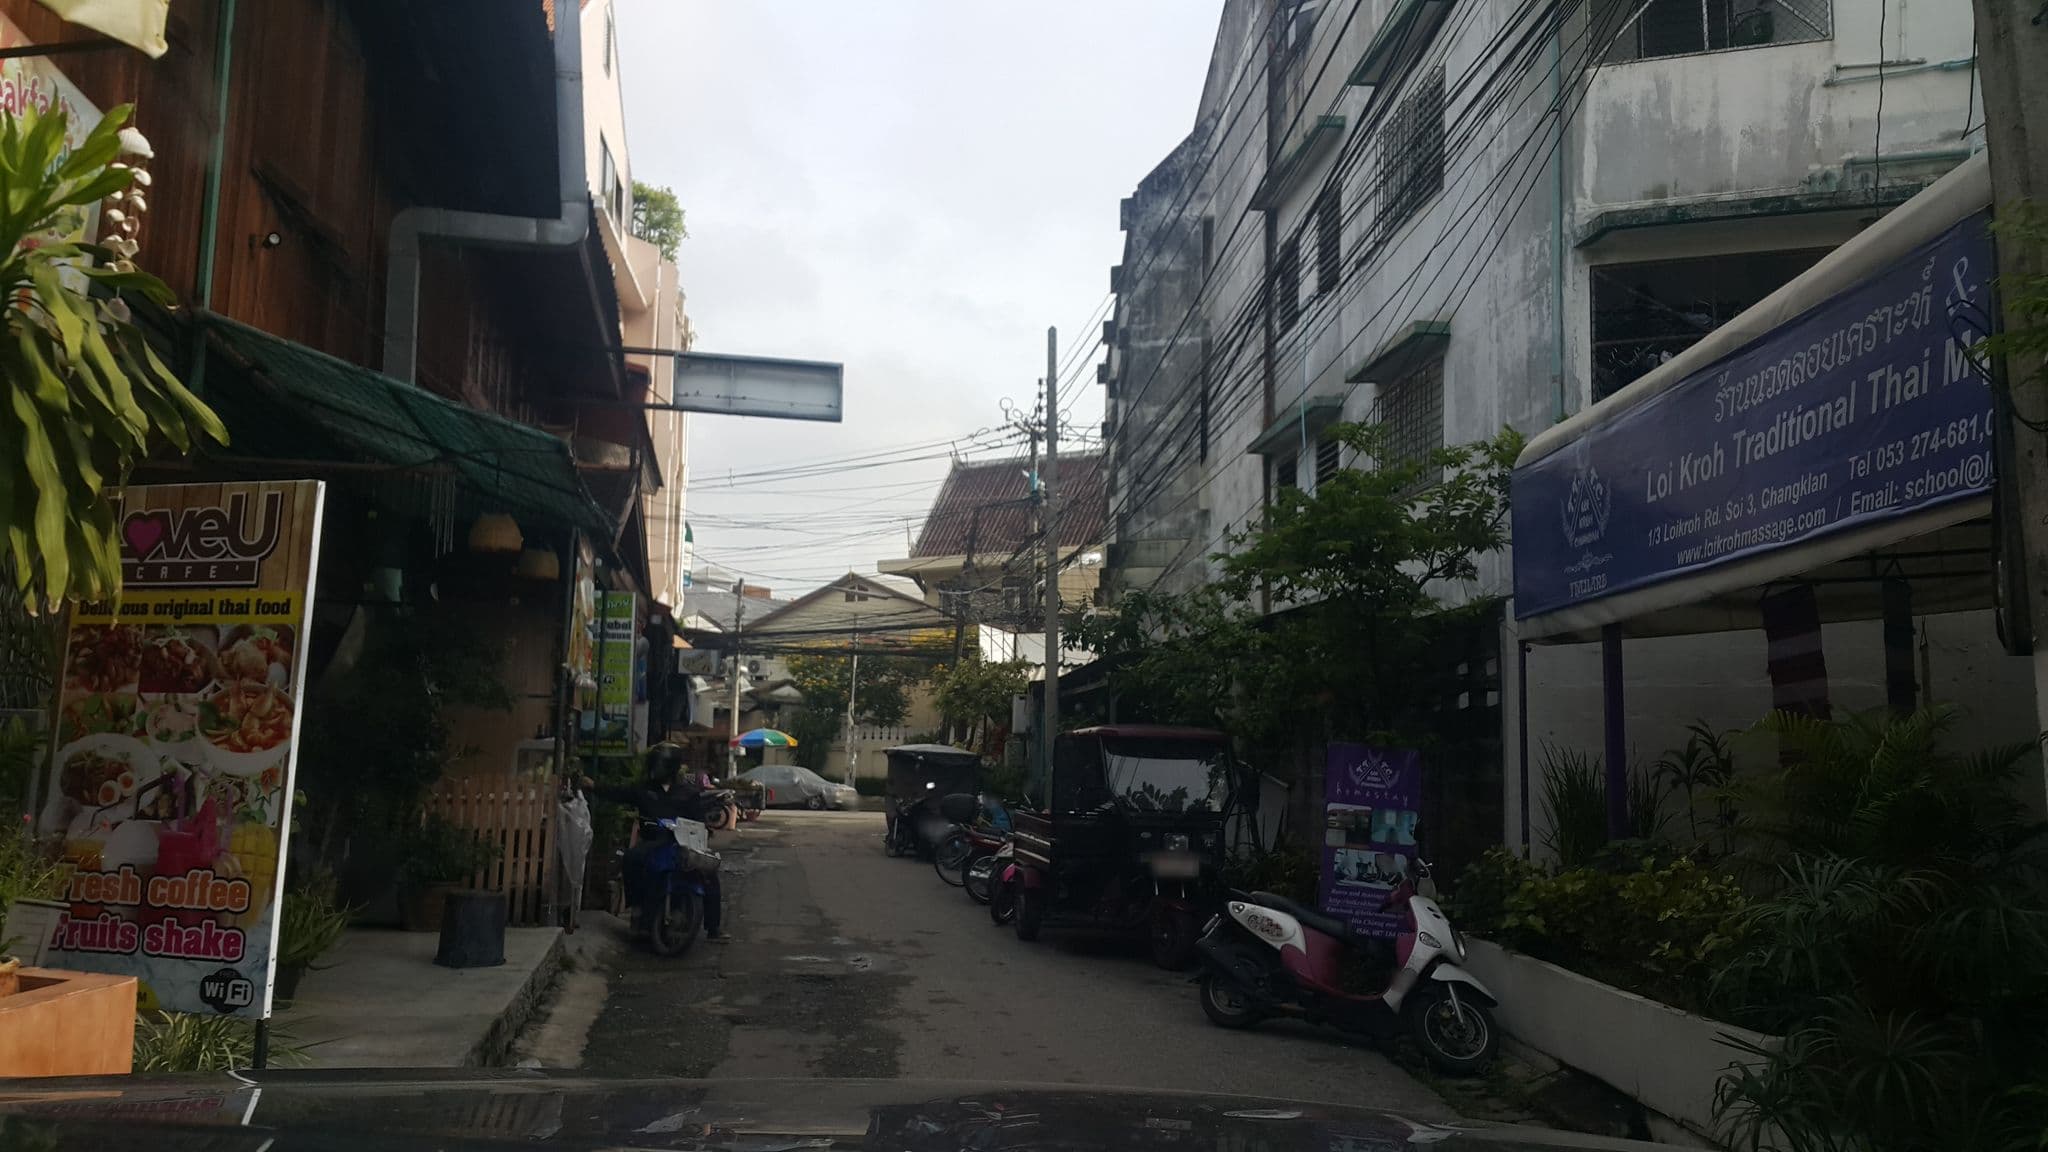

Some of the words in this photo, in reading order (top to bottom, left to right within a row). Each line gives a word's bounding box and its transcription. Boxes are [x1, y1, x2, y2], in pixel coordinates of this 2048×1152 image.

[1646, 459, 1672, 504] Loi
[1679, 441, 1725, 490] Kroh
[1733, 380, 1858, 468] Traditional
[1866, 348, 1931, 414] Thai
[1663, 513, 1701, 542] Loikroh
[1704, 506, 1722, 529] Rd.
[1725, 498, 1744, 521] Soi
[1761, 471, 1828, 508] Changklan
[1848, 450, 1870, 480] Tel
[1876, 440, 1905, 472] 053
[1677, 507, 1826, 565] www.loikrohmassage.com
[1851, 482, 1899, 519] Email:
[153, 599, 214, 619] original
[219, 599, 250, 615] thai
[255, 598, 291, 615] food
[147, 868, 250, 912] coffee
[143, 917, 245, 961] shake
